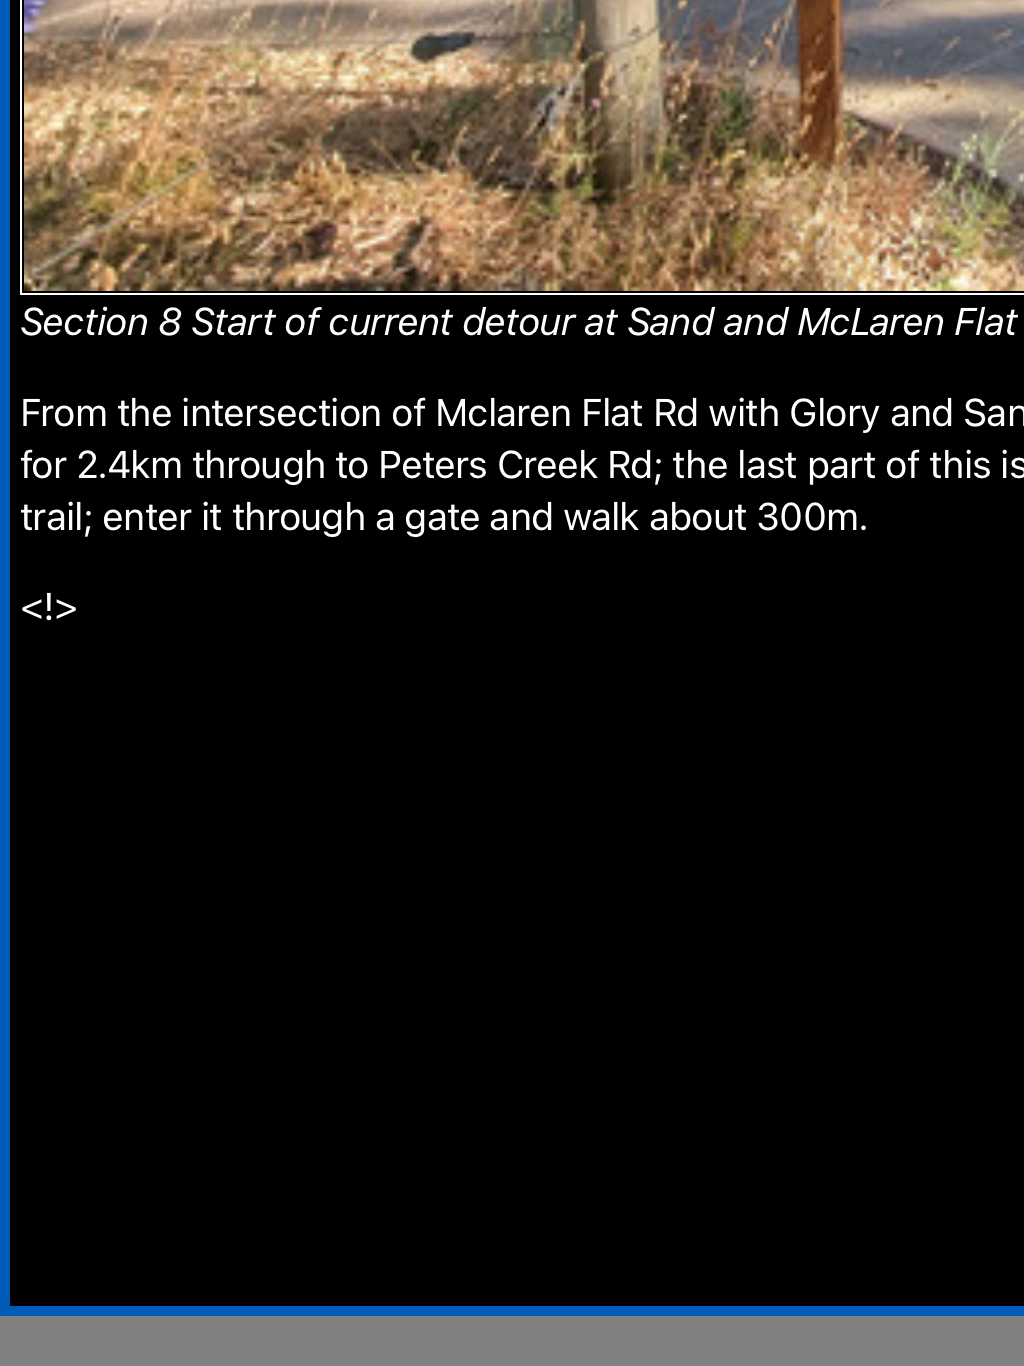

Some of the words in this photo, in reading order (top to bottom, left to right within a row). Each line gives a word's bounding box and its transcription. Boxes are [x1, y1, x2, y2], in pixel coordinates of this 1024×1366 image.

[21, 306, 147, 336] Section
[159, 307, 181, 336] 8
[192, 307, 276, 336] Start
[286, 307, 322, 336] of
[330, 309, 453, 336] current
[463, 307, 577, 336] detour
[585, 309, 618, 336] at
[628, 307, 715, 336] Sand
[724, 307, 789, 336] and
[798, 308, 943, 336] McLaren
[955, 307, 1018, 336] Flat
[23, 399, 105, 426] From
[118, 398, 171, 426] the
[183, 398, 380, 426] intersection
[393, 398, 425, 426] of
[438, 398, 570, 426] Mclaren
[584, 398, 642, 426] Flat
[656, 398, 696, 426] Rd
[709, 398, 778, 426] with
[791, 398, 879, 433] Glory
[892, 398, 951, 426] and
[21, 450, 66, 478] for
[79, 450, 180, 478] 2.4km
[193, 450, 324, 485] through
[336, 452, 368, 478] to
[381, 451, 486, 478] Peters
[499, 450, 598, 479] Creek
[610, 450, 661, 485] Rd;
[673, 450, 727, 478] the
[740, 450, 796, 478] last
[810, 452, 875, 485] part
[887, 450, 919, 478] of
[930, 450, 990, 478] this
[21, 501, 91, 537] trail;
[104, 504, 192, 531] enter
[203, 501, 221, 530] it
[233, 502, 364, 537] through
[377, 509, 393, 531] a
[406, 504, 479, 537] gate
[491, 502, 552, 531] and
[564, 502, 639, 531] walk
[651, 502, 746, 531] about
[758, 502, 866, 531] 300m.
